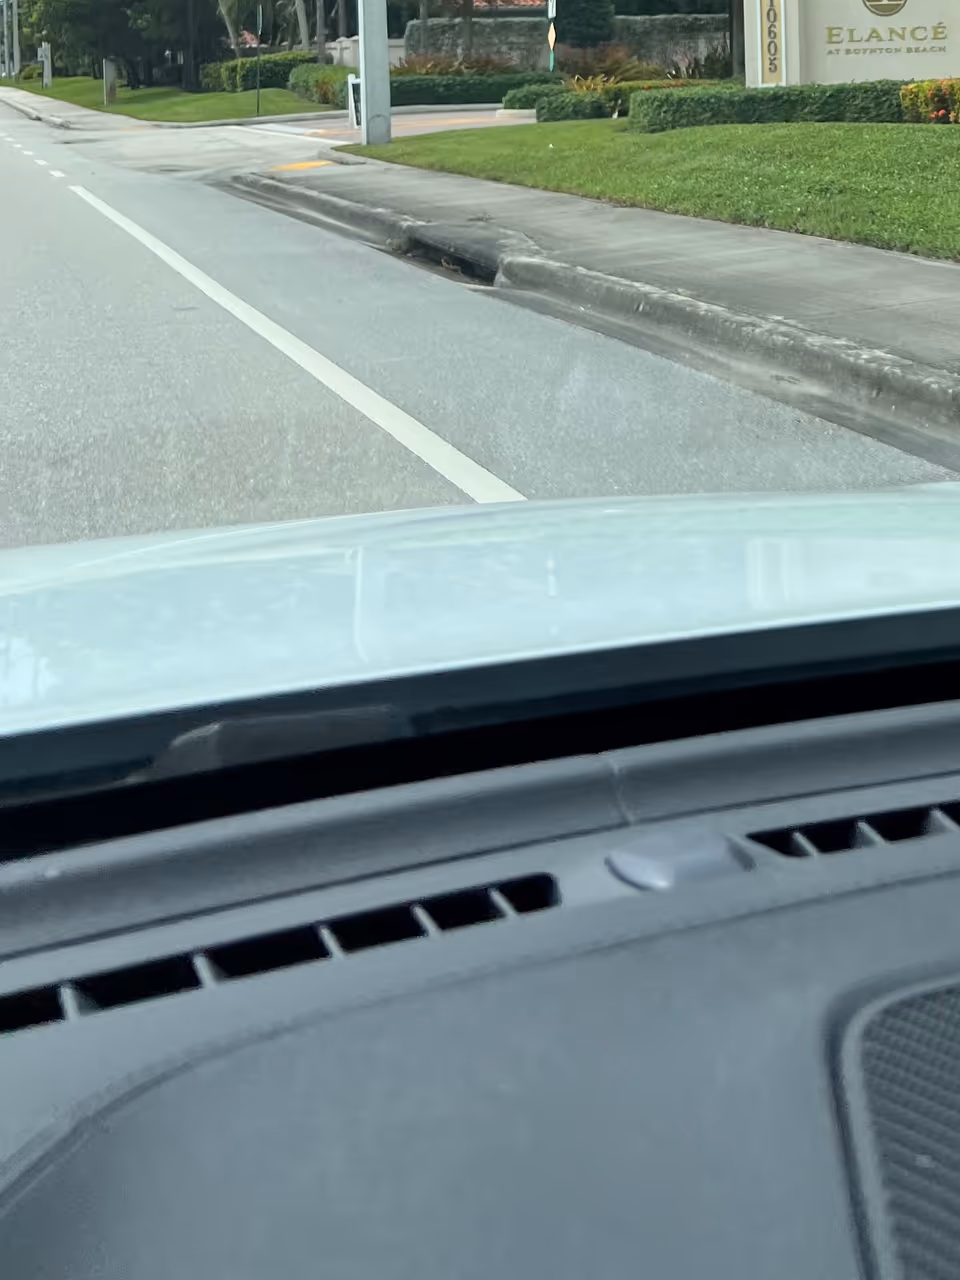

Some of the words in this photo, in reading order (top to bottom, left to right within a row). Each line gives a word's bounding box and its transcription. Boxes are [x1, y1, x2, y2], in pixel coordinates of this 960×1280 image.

[825, 22, 948, 44] ELANCÉ
[826, 48, 841, 56] AT
[845, 47, 902, 56] BOYNTON
[906, 45, 947, 54] BEACH
